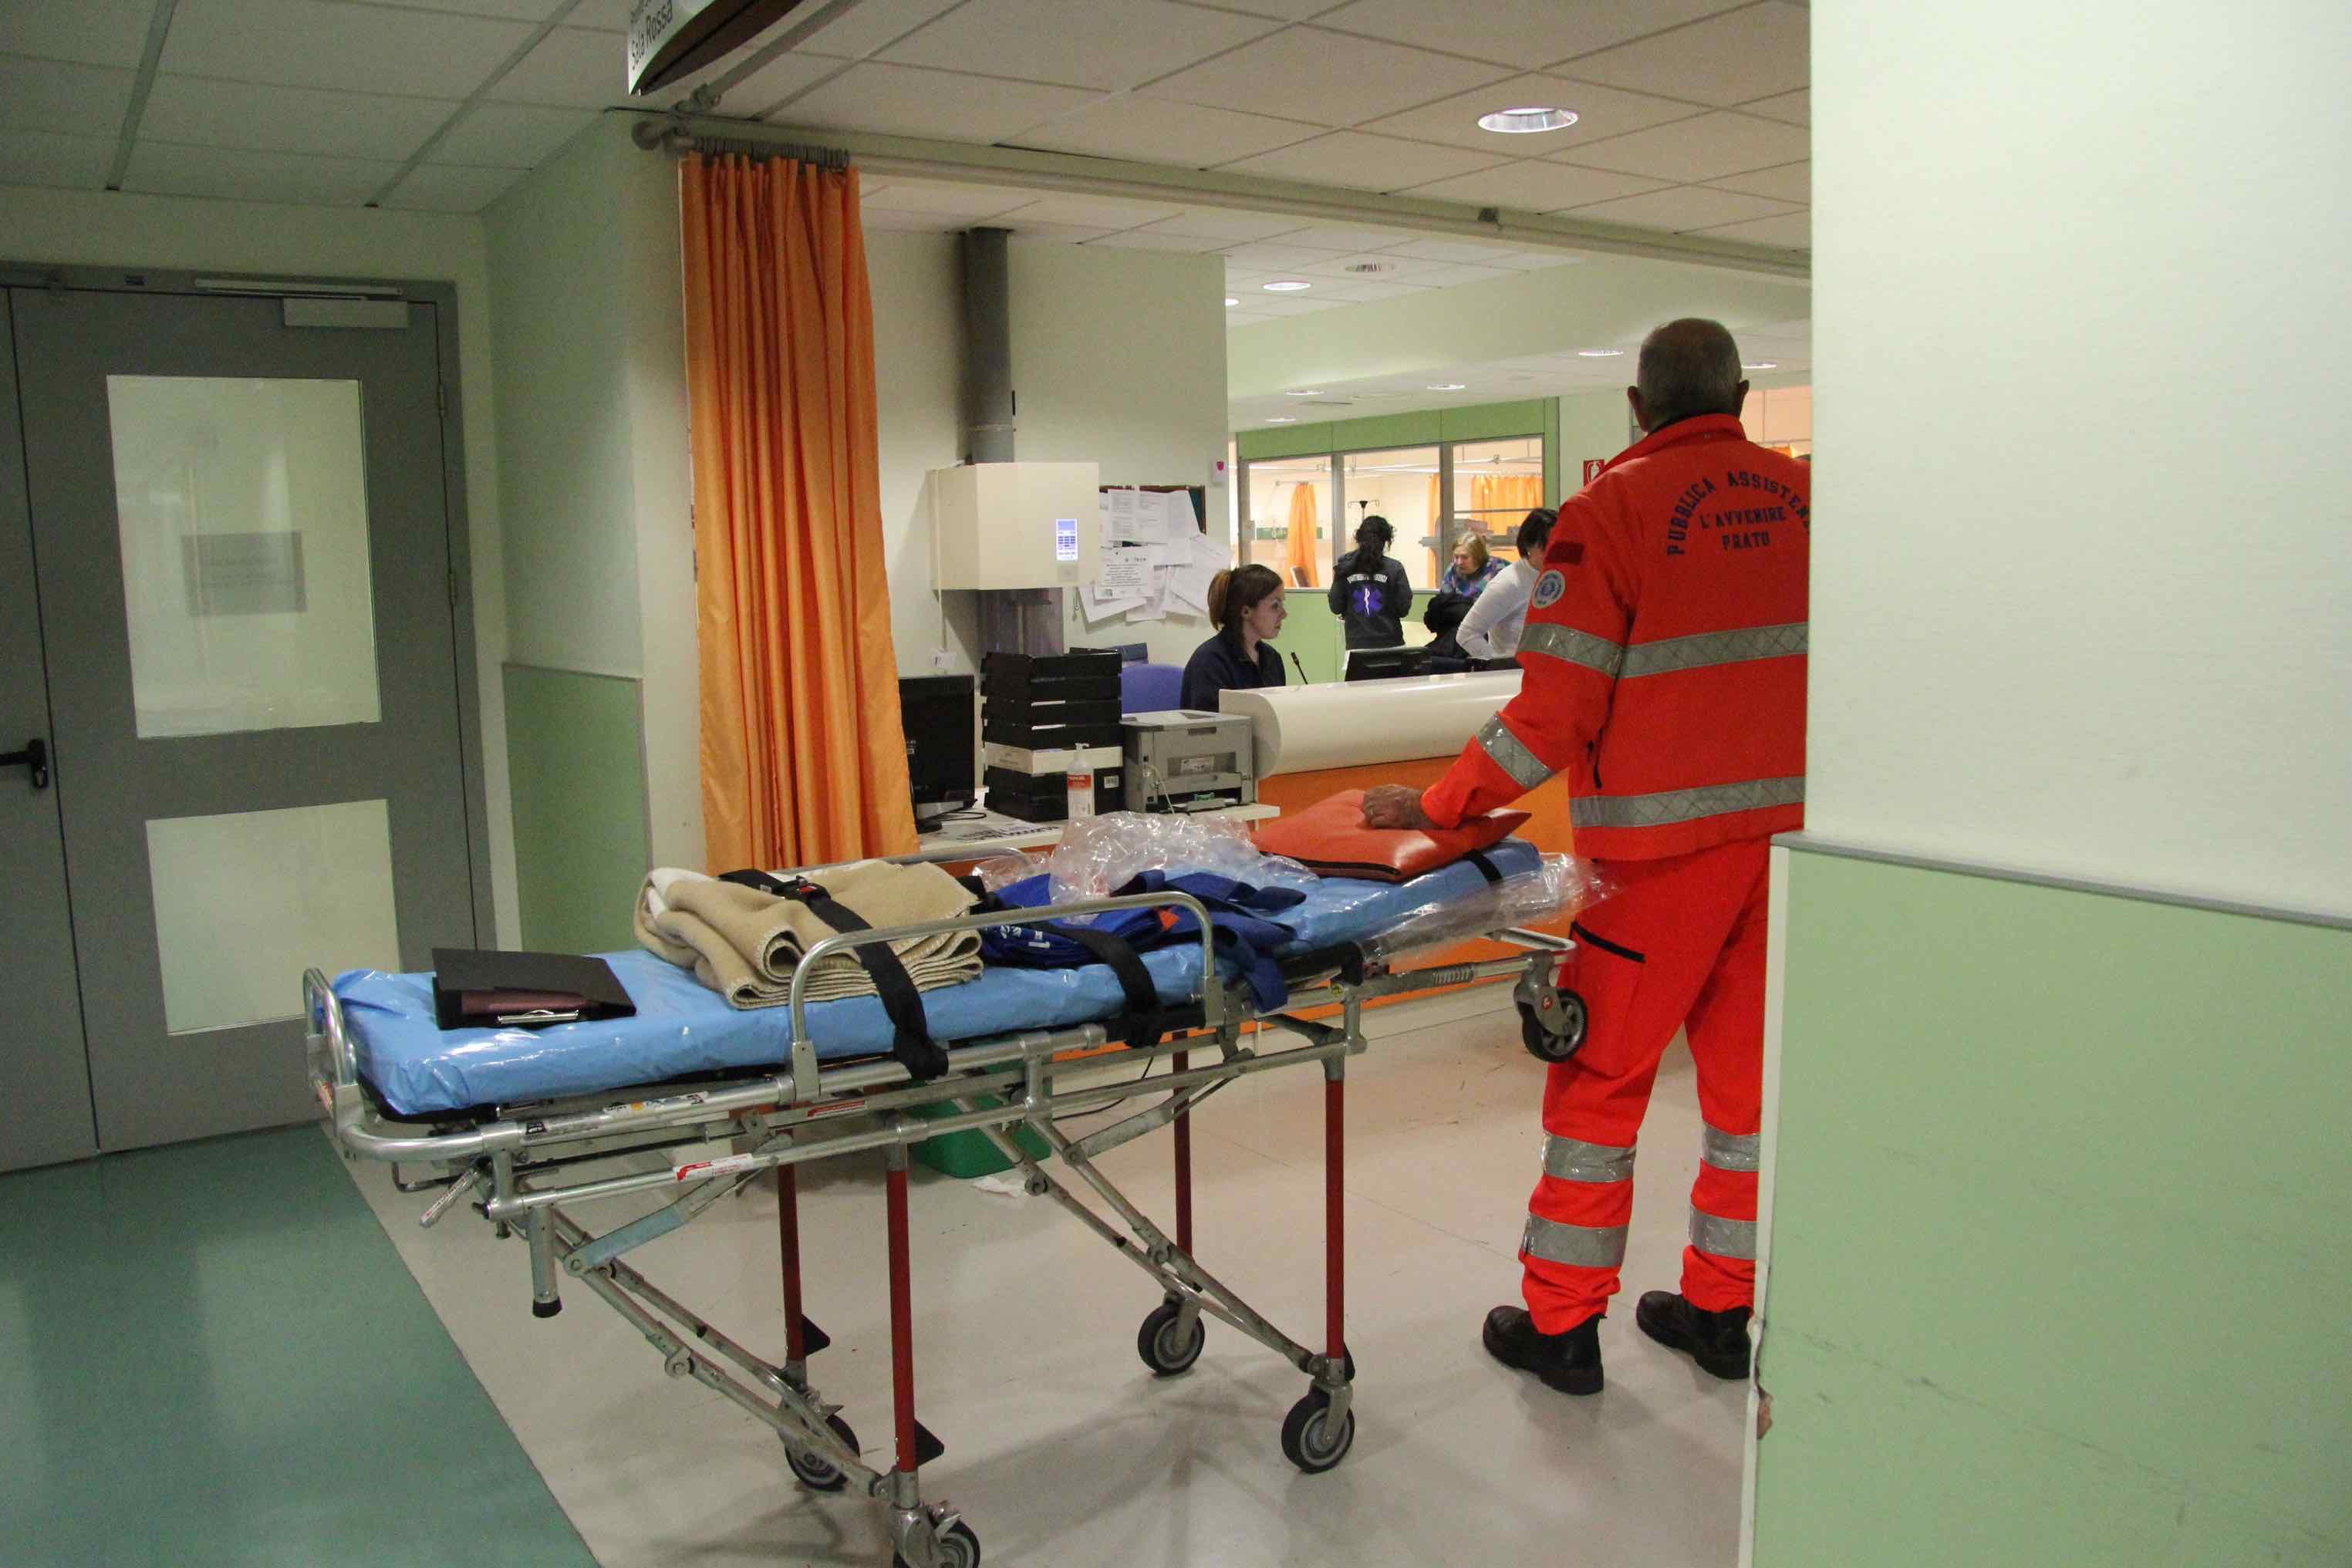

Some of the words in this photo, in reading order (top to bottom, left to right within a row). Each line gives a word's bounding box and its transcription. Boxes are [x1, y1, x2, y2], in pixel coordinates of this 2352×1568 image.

[646, 0, 673, 49] Rossa
[1667, 477, 1716, 555] PUBBLICA
[1721, 531, 1770, 550] PRATO
